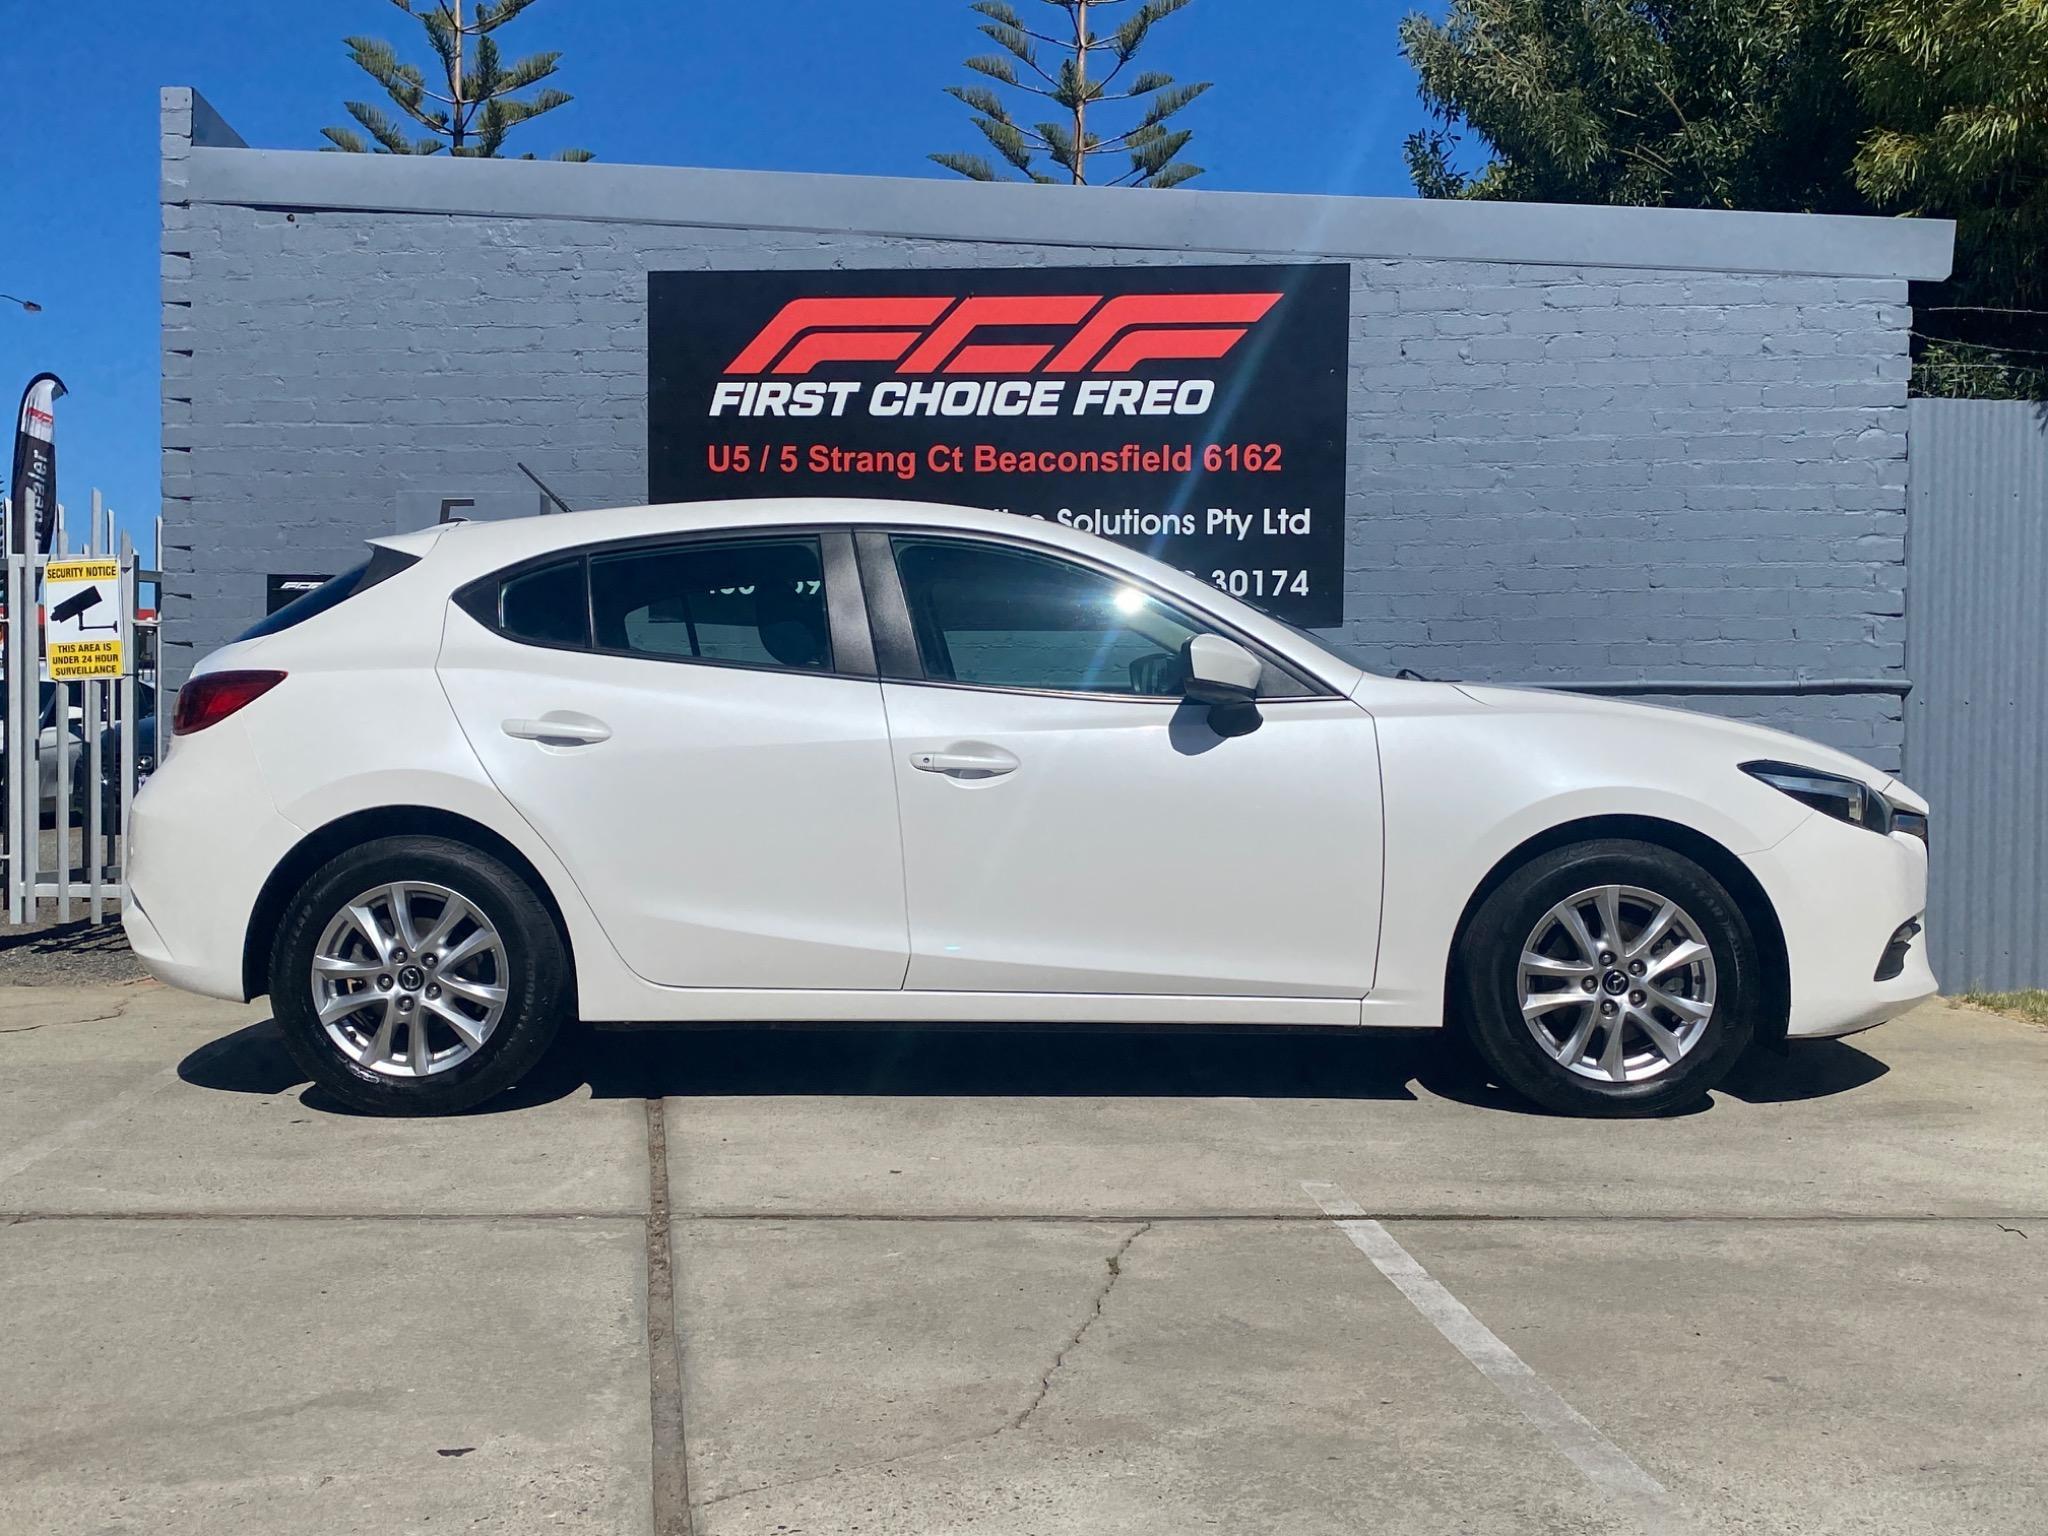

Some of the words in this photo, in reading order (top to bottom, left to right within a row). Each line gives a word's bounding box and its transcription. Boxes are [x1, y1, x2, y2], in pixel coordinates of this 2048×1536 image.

[709, 382, 861, 417] FIRST
[868, 381, 1066, 417] CHOICE
[1072, 380, 1215, 416] FREO
[708, 445, 751, 472] U5
[759, 445, 771, 472] /
[780, 445, 798, 472] 5
[808, 445, 917, 479] Strang
[927, 444, 964, 472] Ct
[975, 444, 1192, 472] Beaconsfield
[1203, 444, 1282, 471] 6162
[1057, 508, 1195, 535] Solutions
[1206, 508, 1253, 541] Pty
[1263, 508, 1311, 535] Ltd
[47, 567, 85, 579] SECURITY
[86, 566, 116, 577] NOTICE
[1211, 569, 1309, 597] 30174
[57, 645, 76, 653] THIS
[78, 643, 100, 652] AREA
[103, 642, 112, 651] IS
[52, 656, 80, 665] UNDER
[82, 655, 93, 664] 24
[95, 654, 119, 662] HOUR
[55, 665, 116, 676] SURVEILLANCE
